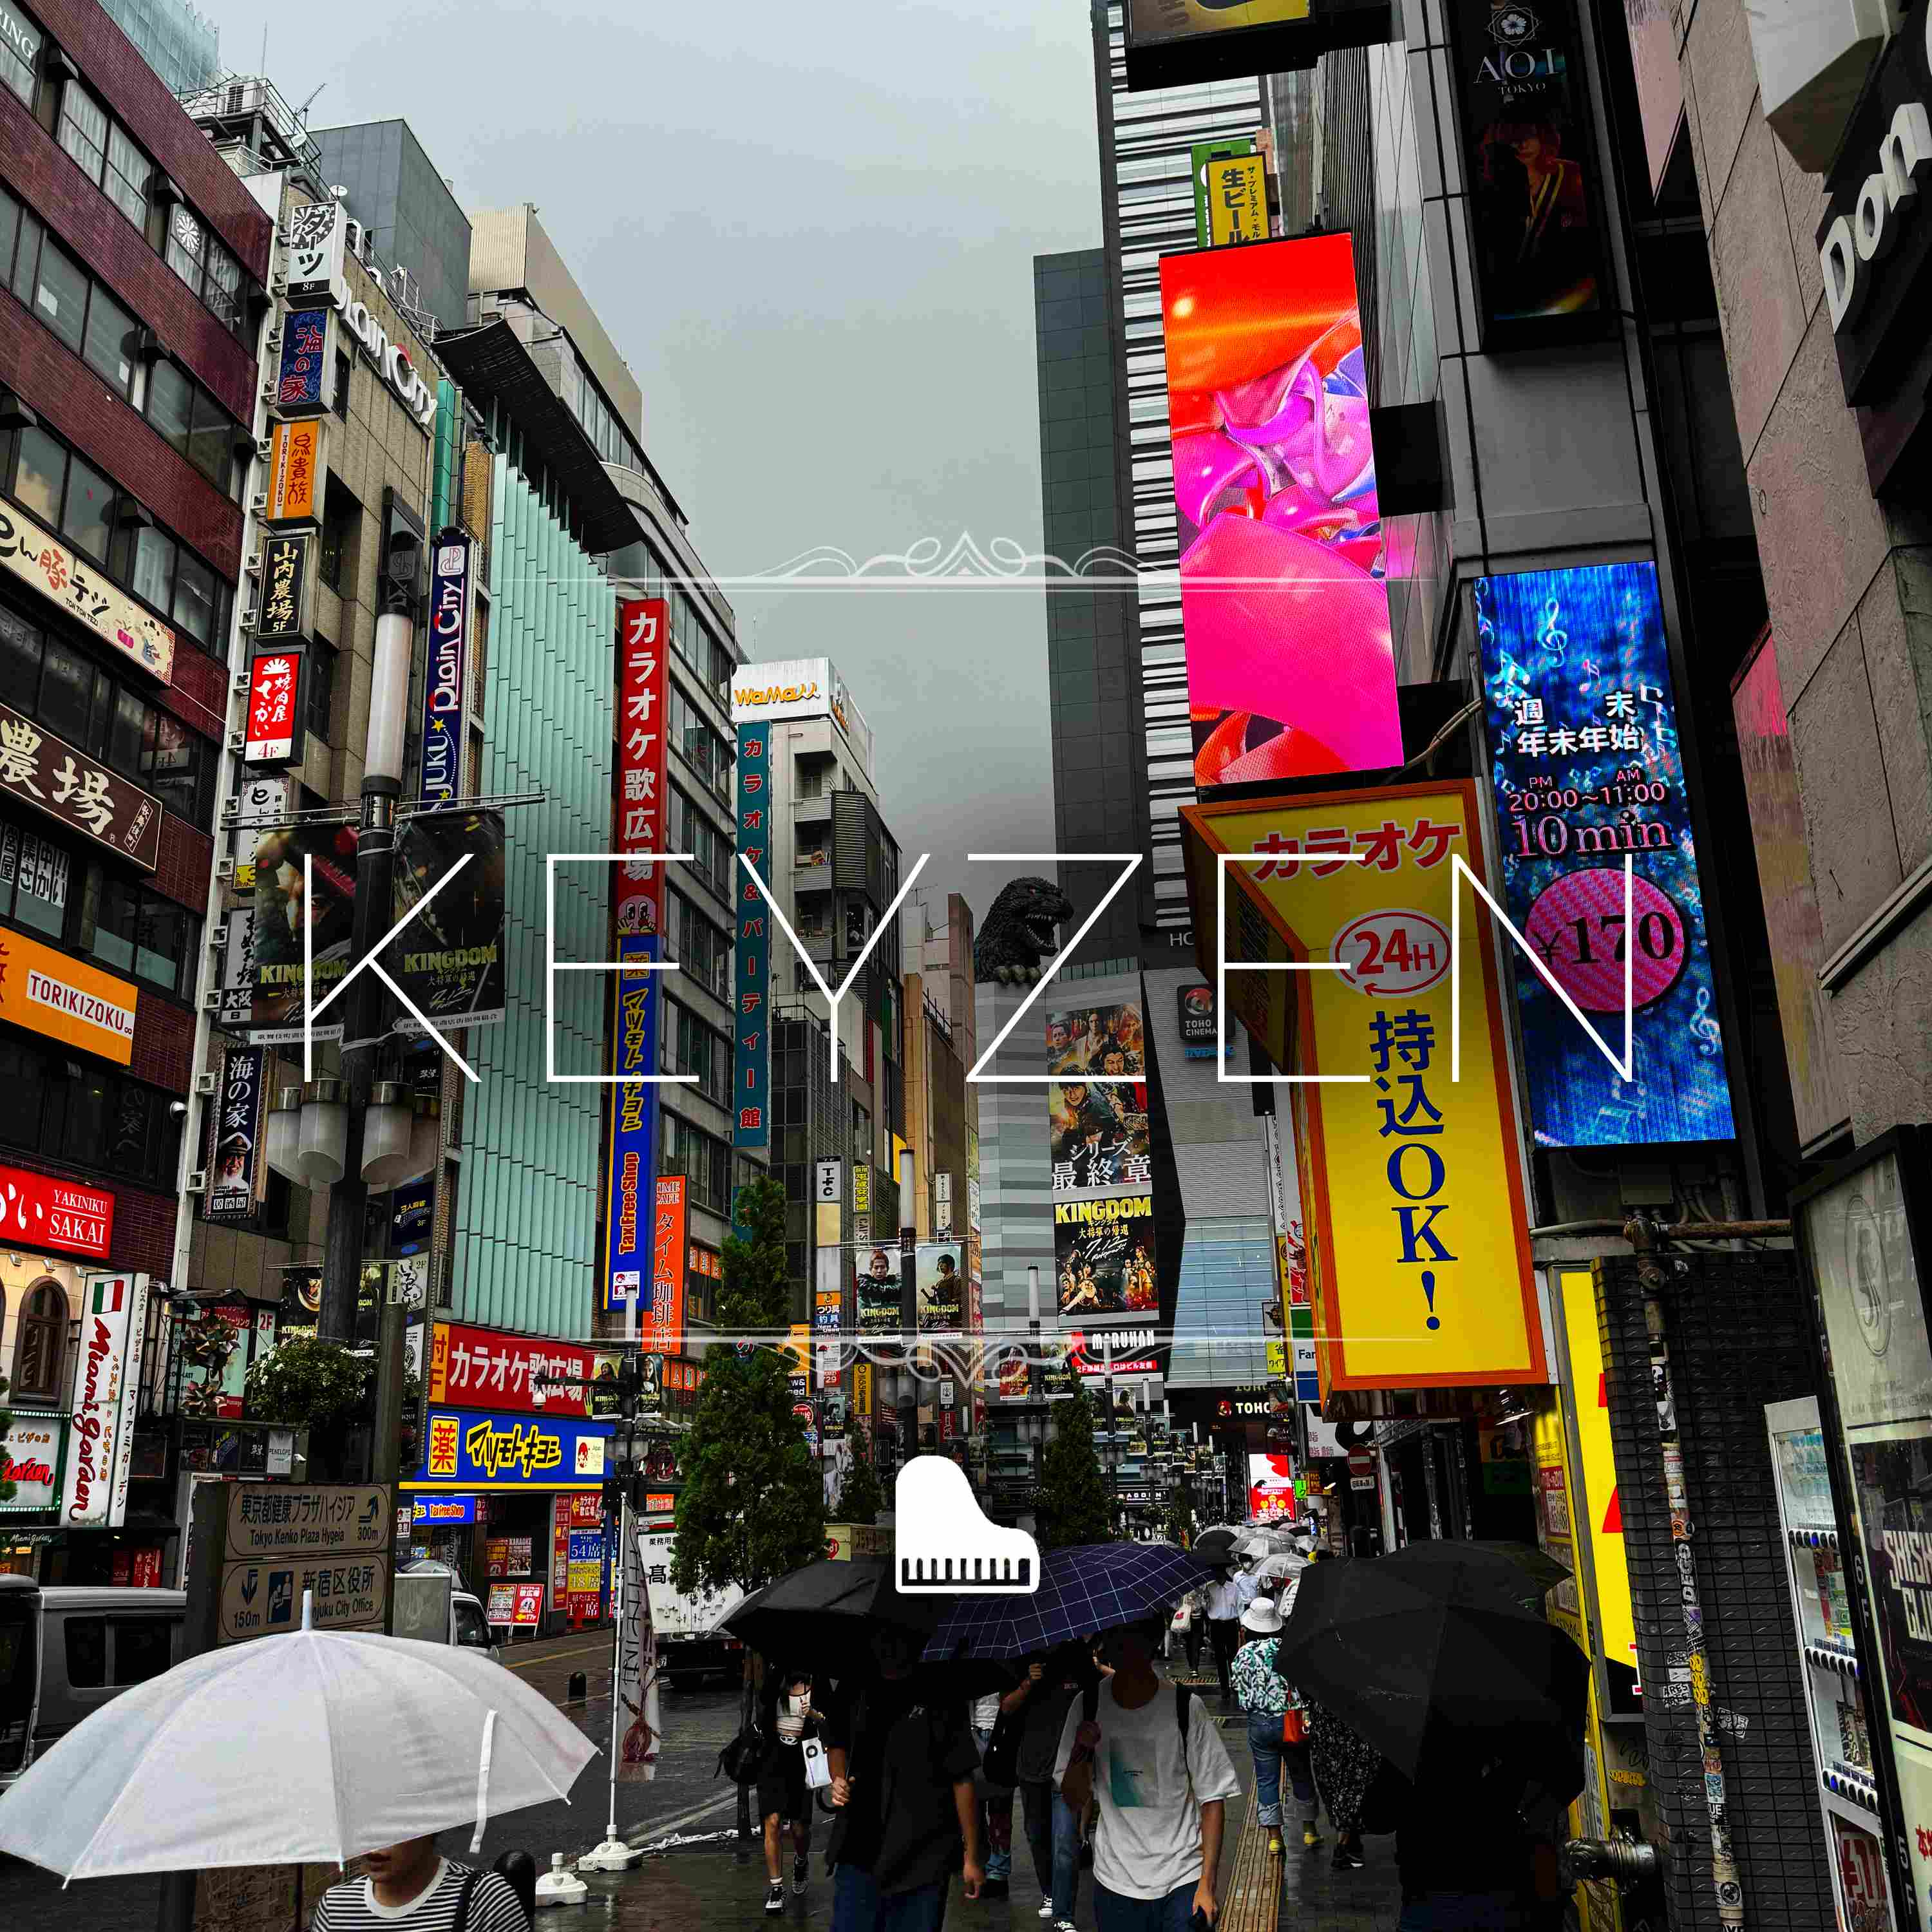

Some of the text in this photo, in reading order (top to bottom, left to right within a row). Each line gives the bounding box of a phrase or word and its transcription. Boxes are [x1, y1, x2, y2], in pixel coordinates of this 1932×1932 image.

[0, 6, 33, 59] ING
[1473, 48, 1560, 84] AOI
[296, 205, 333, 277] ダーツ
[302, 281, 315, 291] 8F
[279, 325, 323, 402] 海の家
[277, 434, 289, 507] TORIKIZOKU
[266, 541, 298, 621] 山内農場
[272, 620, 287, 632] 5F
[271, 672, 294, 723] 焼肉屋
[257, 741, 279, 759] 4F
[623, 612, 658, 882] カラオケ歌広場
[1517, 724, 1643, 757] 年末年始
[425, 733, 453, 805] JUKU
[1530, 769, 1641, 788] PM AM
[1250, 818, 1463, 882] カラオケ
[739, 739, 764, 1129] カラオケ&パーティー館
[403, 944, 497, 973] KINGDOM
[30, 974, 126, 1031] TORIKIZOKU
[1185, 1019, 1211, 1028] TOHO
[1186, 1028, 1218, 1036] CINEMA
[621, 988, 649, 1133] マツモトキヨシ
[225, 1056, 254, 1129] 海の家
[1069, 1135, 1133, 1161] シリーズ
[1051, 1154, 1152, 1190] 最終章
[54, 1189, 108, 1214] YAKINIKU
[618, 1151, 640, 1255] Tax Free Shop
[1055, 1196, 1153, 1224] KINGDOM
[49, 1213, 106, 1244] SAKAI
[650, 1213, 675, 1352] タイム珈琲店
[259, 1313, 274, 1331] 2F
[450, 1342, 583, 1401] カラオケ歌広場
[69, 1317, 113, 1522] Miami Garden
[433, 1422, 457, 1473] 薬
[466, 1419, 562, 1477] マツモトキヨシ
[240, 1493, 355, 1525] 東京都健康プラザハイジア
[429, 1504, 465, 1519] Tax Free Shop
[250, 1528, 345, 1549] Tokyo Kenko Plaza Hygeia
[357, 1527, 379, 1541] 300m
[301, 1565, 375, 1598] 新宿区役所
[234, 1611, 260, 1629] 150m
[336, 1600, 350, 1617] City
[352, 1599, 374, 1614] Office
